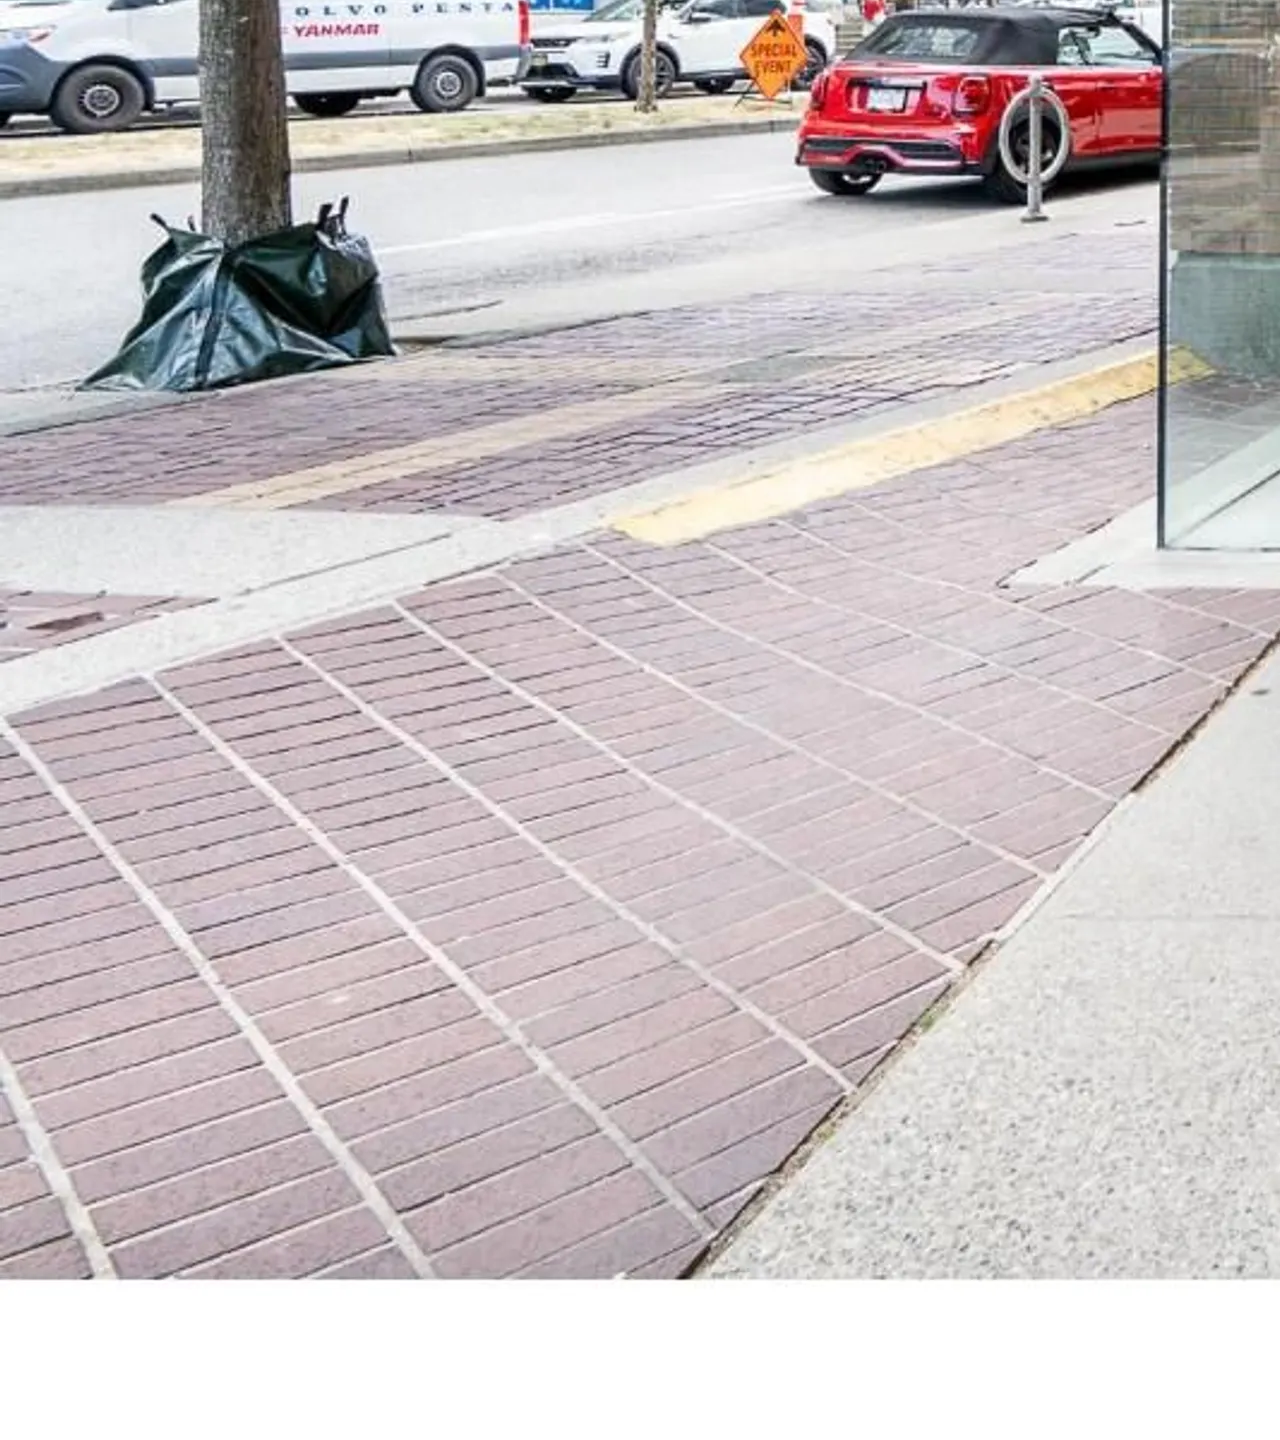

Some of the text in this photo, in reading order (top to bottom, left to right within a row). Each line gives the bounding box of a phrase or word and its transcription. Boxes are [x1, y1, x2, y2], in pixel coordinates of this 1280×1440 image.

[294, 2, 514, 17] OLVO PENTA
[294, 23, 381, 37] YANMAR
[751, 44, 797, 57] SPECIAL
[755, 60, 791, 77] EVENT
